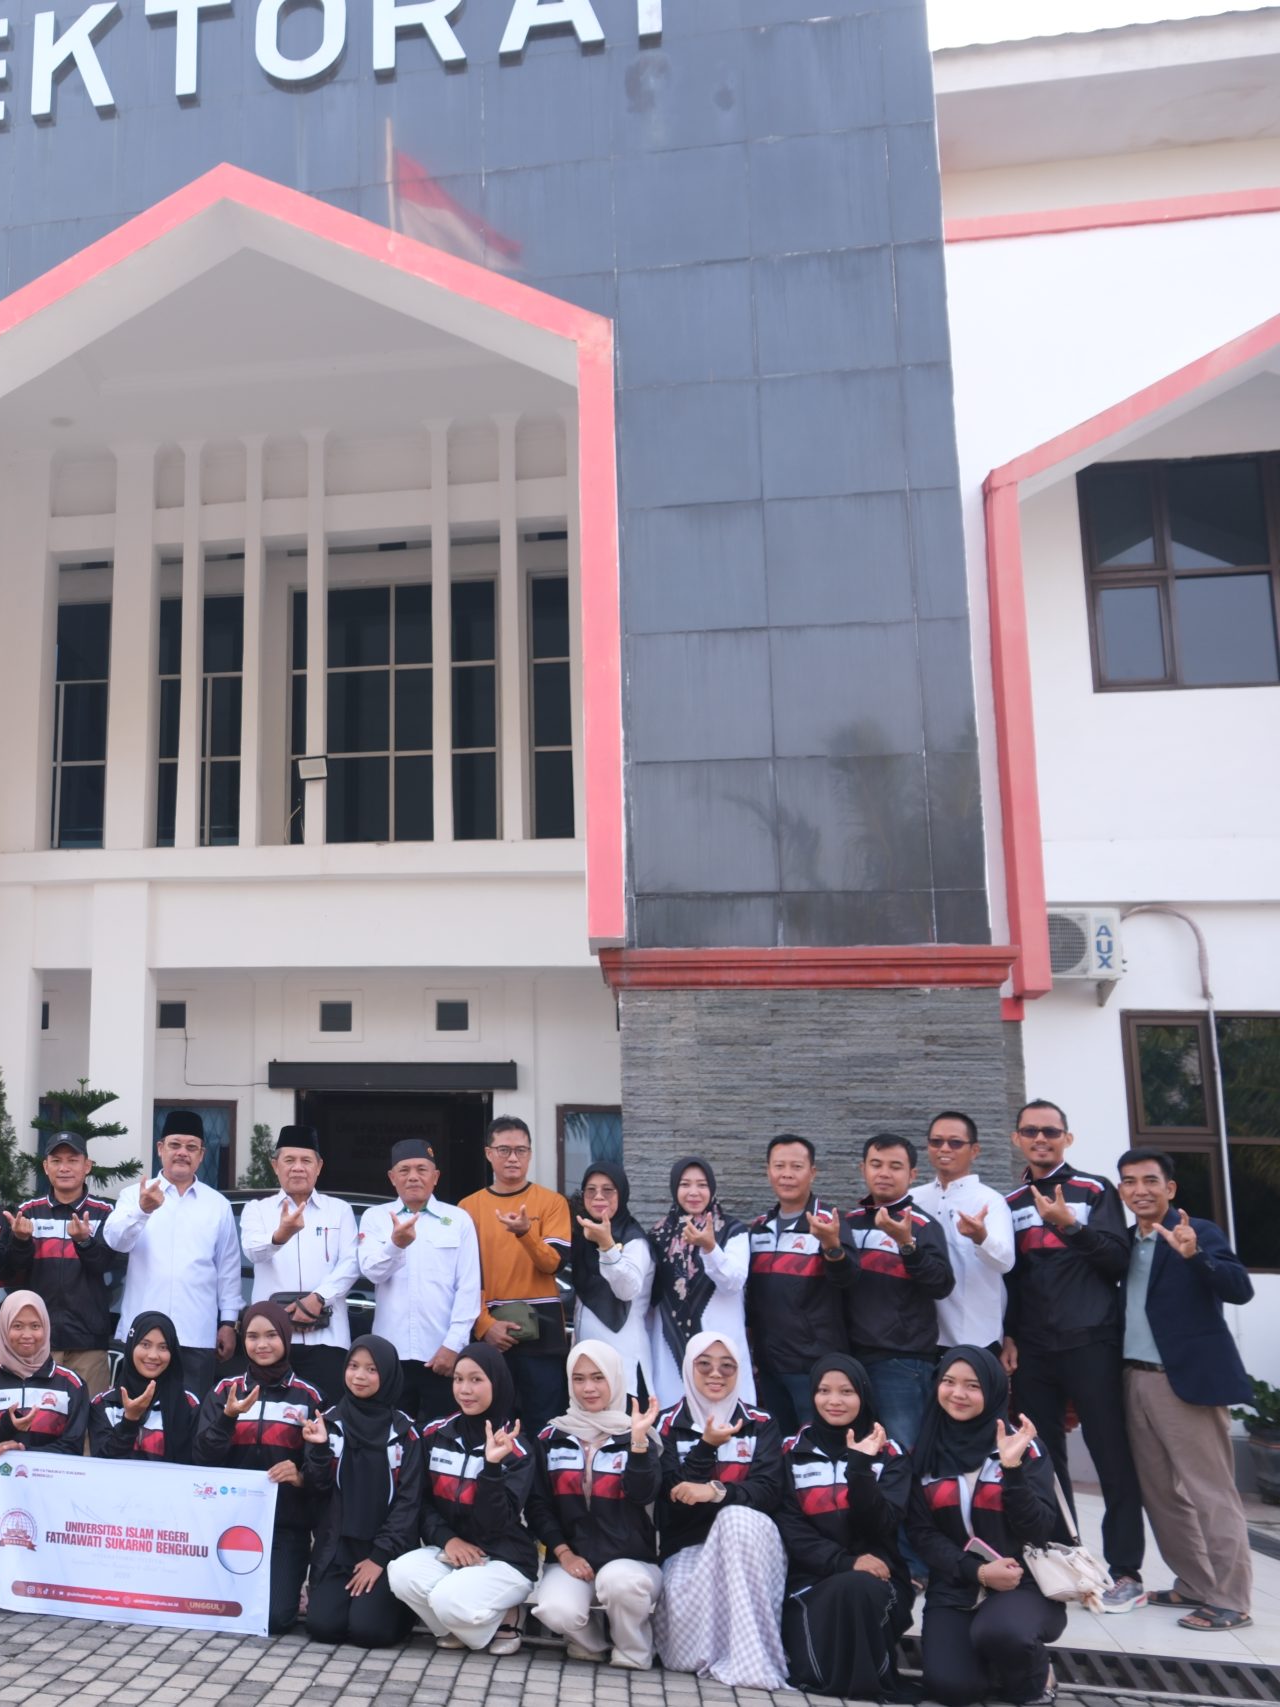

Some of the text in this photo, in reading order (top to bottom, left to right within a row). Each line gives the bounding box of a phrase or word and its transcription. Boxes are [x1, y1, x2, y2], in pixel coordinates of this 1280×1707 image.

[1096, 925, 1113, 969] AUX
[65, 1521, 189, 1543] UNIVERSITAS ISLAM NEGERI
[46, 1531, 101, 1548] FATMAWATI
[105, 1538, 152, 1553] SUKARNO
[156, 1541, 209, 1558] BENGKULU
[189, 1602, 221, 1610] UNGGUL
